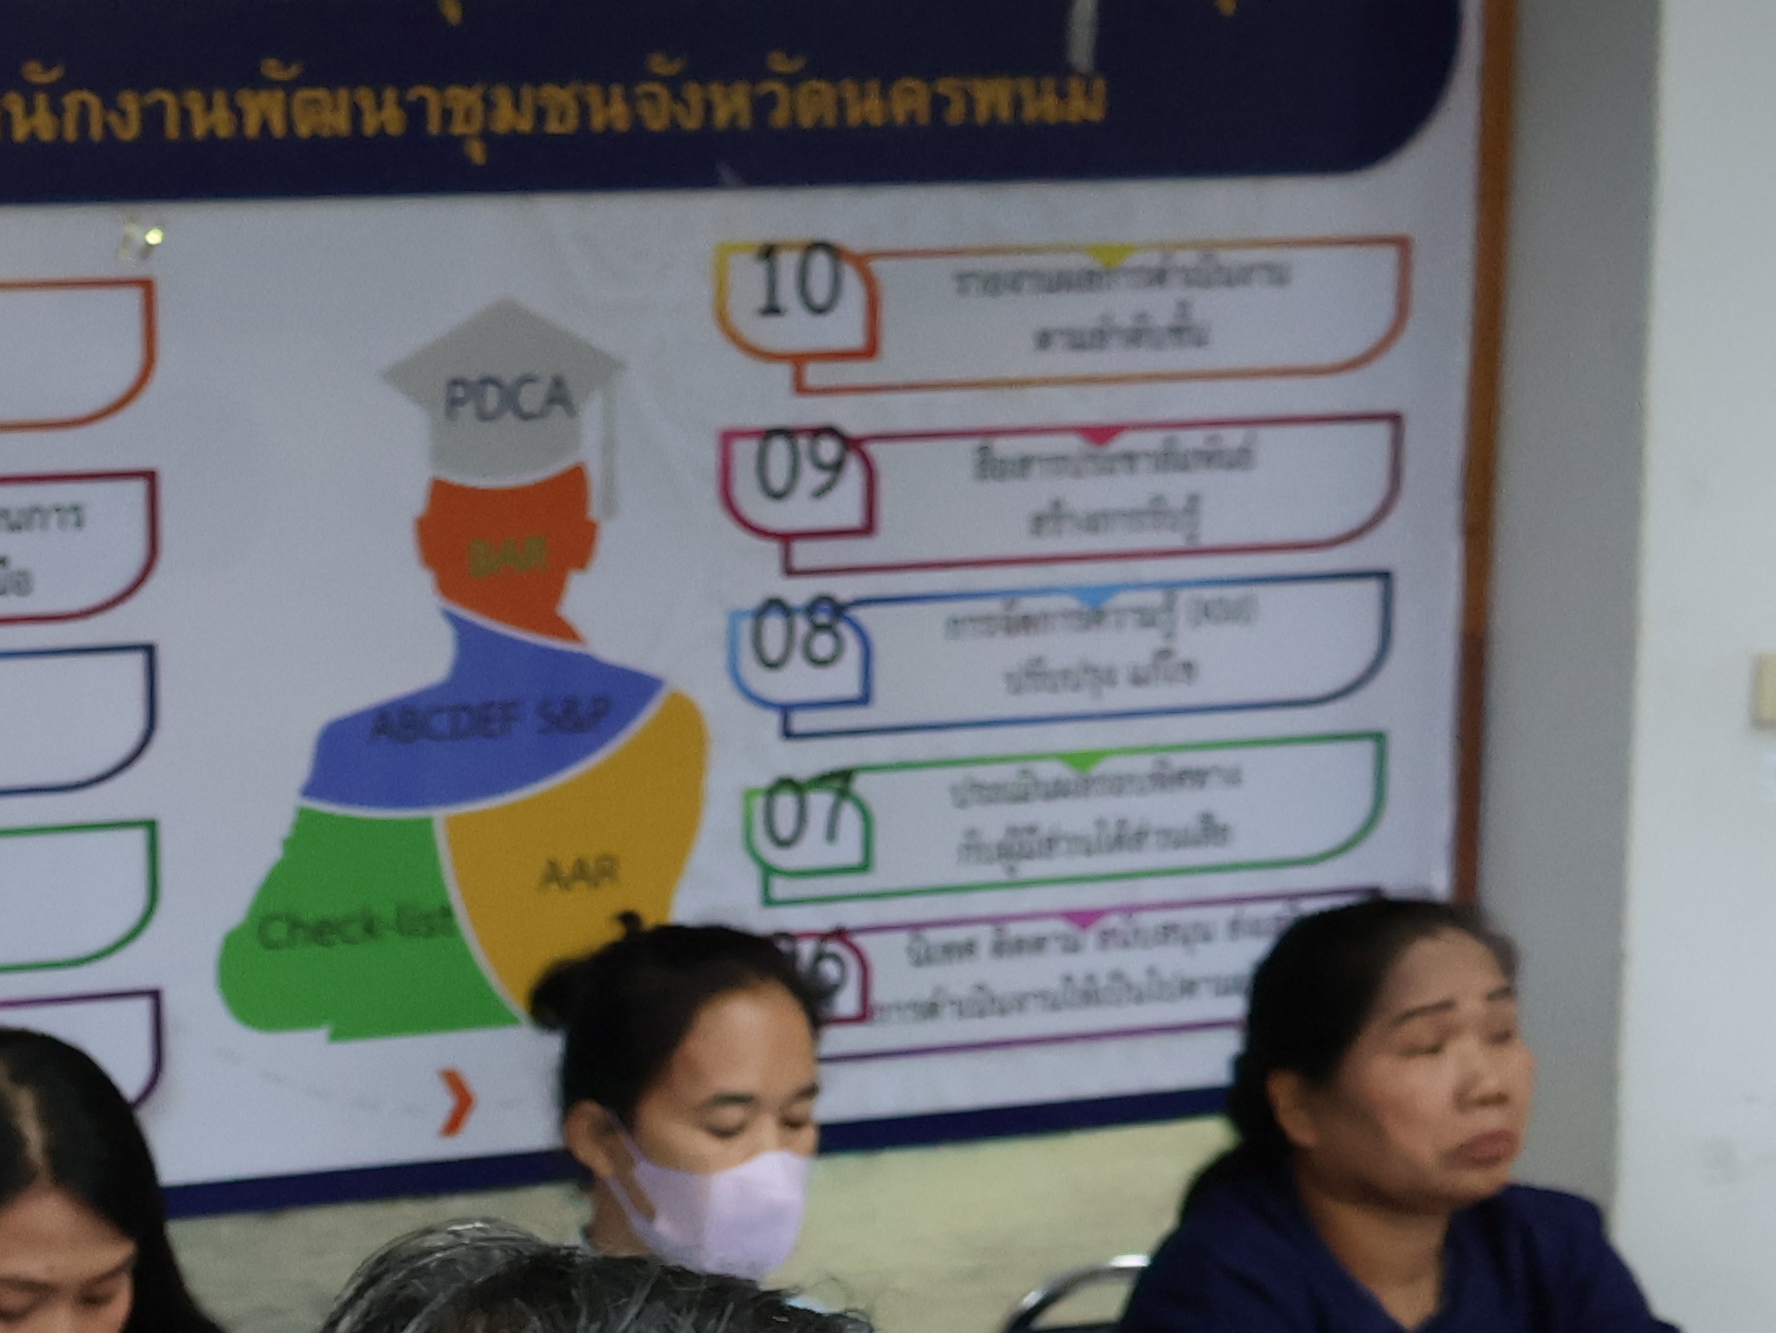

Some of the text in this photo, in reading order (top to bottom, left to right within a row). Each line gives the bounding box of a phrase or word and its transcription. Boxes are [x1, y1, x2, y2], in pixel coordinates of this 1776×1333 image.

[757, 241, 843, 316] 10
[447, 374, 576, 422] PDCA
[757, 426, 848, 500] 09
[753, 595, 846, 670] 08
[370, 695, 612, 745] ABCDEF S&P
[764, 770, 856, 849] 07
[539, 854, 618, 893] AAR
